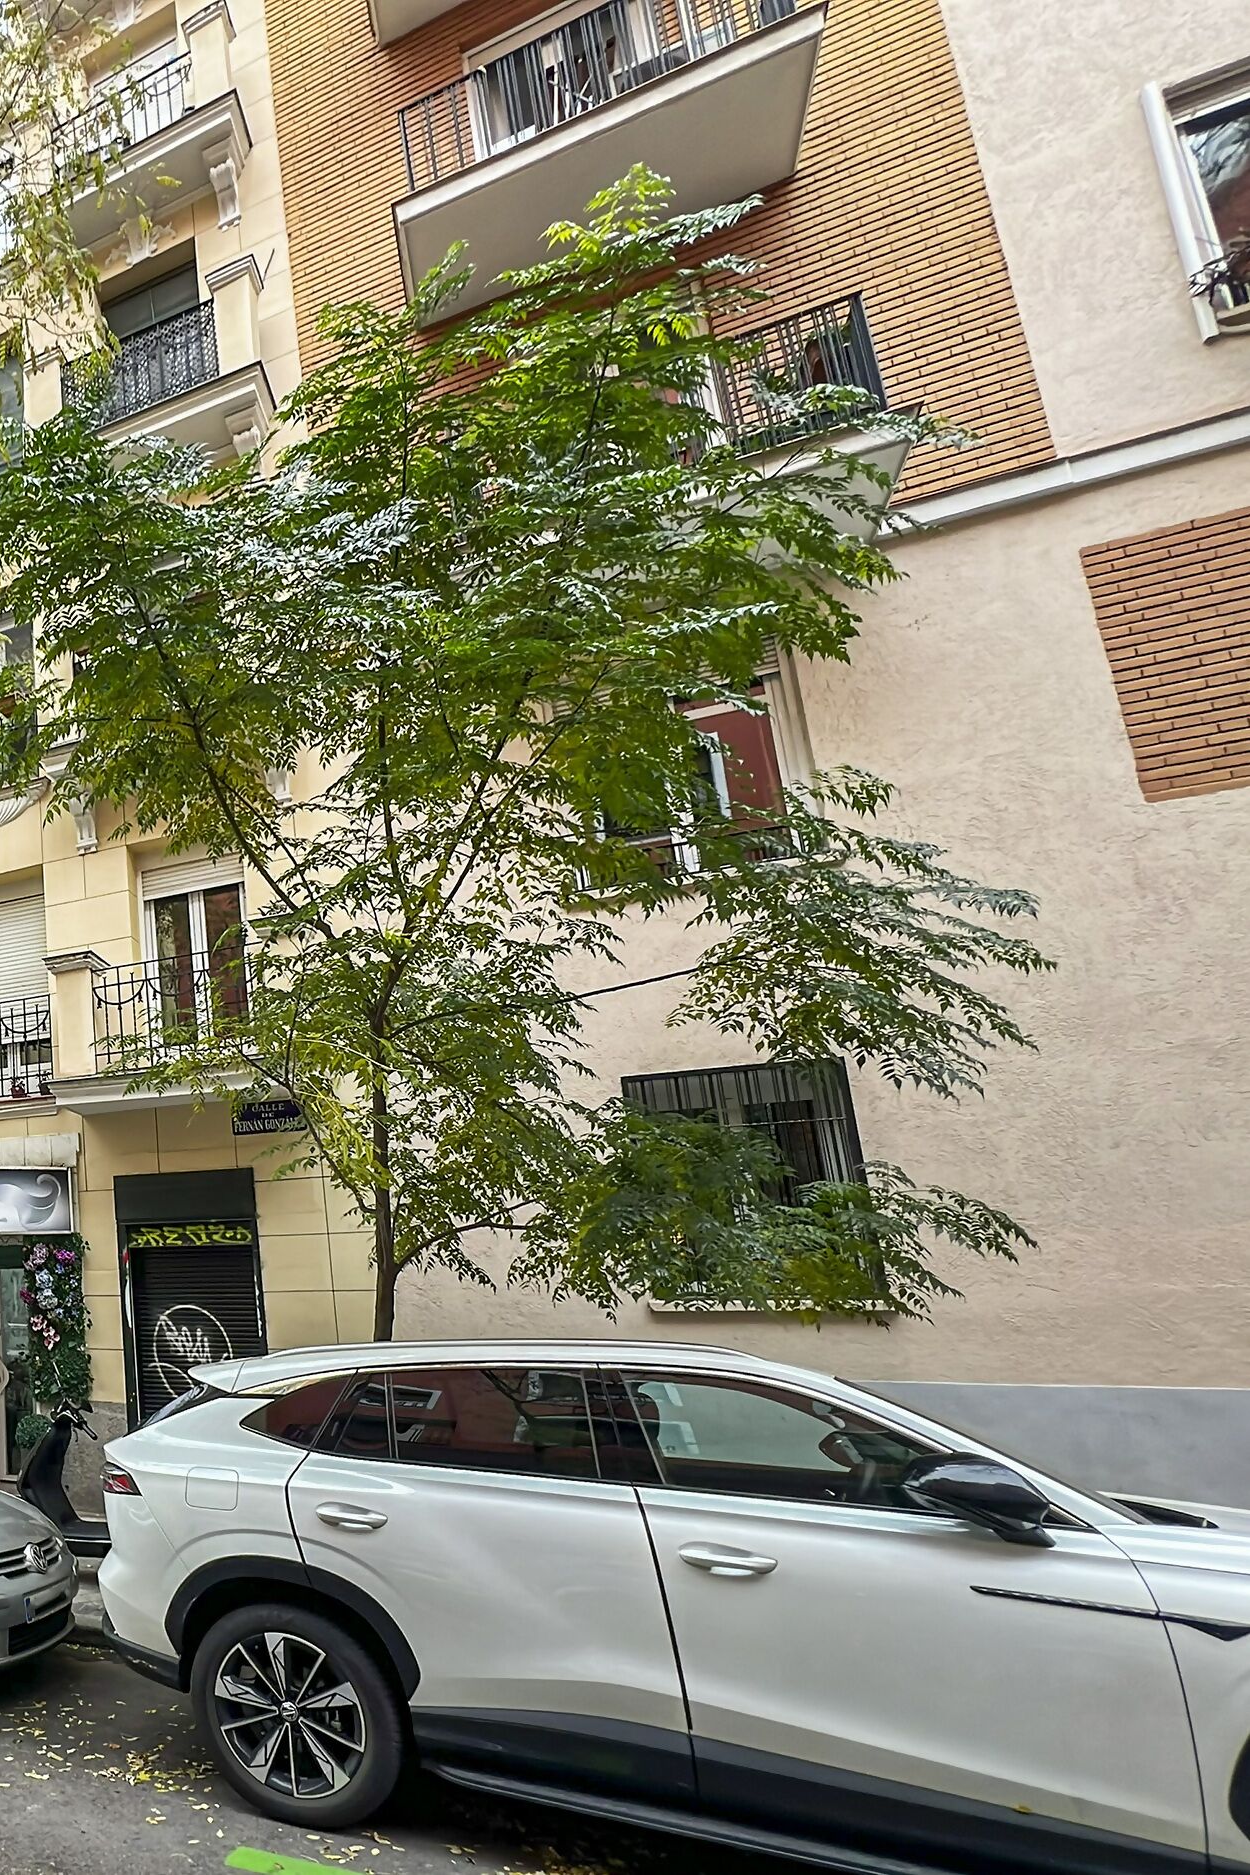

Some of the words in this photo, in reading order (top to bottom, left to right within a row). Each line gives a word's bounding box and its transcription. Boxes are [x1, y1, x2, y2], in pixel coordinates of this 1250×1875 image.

[251, 1102, 285, 1113] CALLE
[261, 1111, 275, 1119] DE
[234, 1117, 264, 1133] FERNÁN
